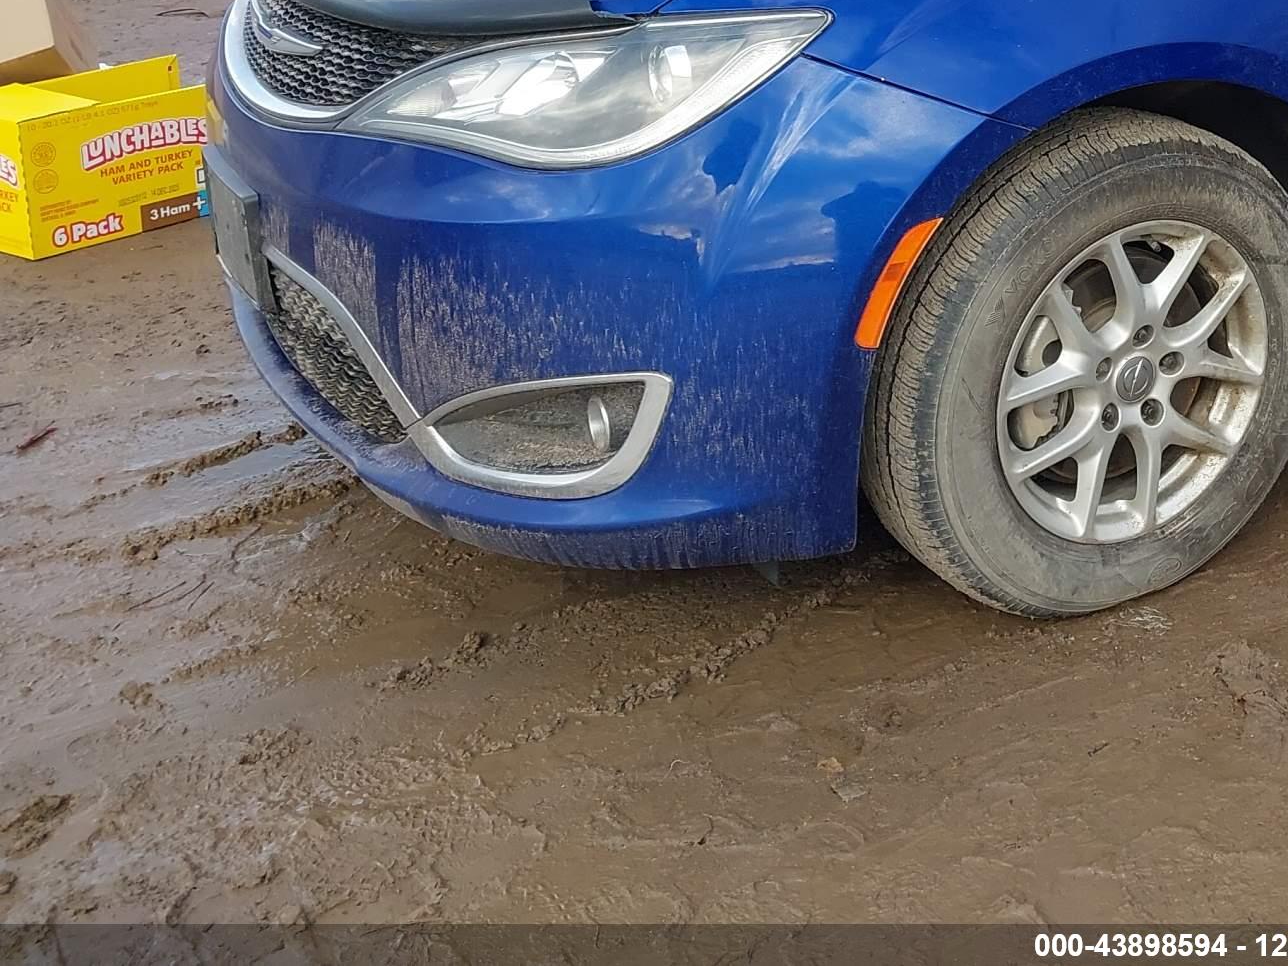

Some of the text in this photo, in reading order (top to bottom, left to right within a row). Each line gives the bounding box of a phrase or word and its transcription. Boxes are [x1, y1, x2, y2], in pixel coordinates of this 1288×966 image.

[81, 118, 208, 170] LUNCHABLES
[100, 164, 125, 179] HAM
[128, 158, 152, 172] AND
[155, 149, 193, 165] TURKEY
[111, 161, 184, 186] VARIETY PACK
[150, 208, 160, 221] 3
[161, 203, 191, 219] Ham
[52, 212, 125, 247] 6 Pack
